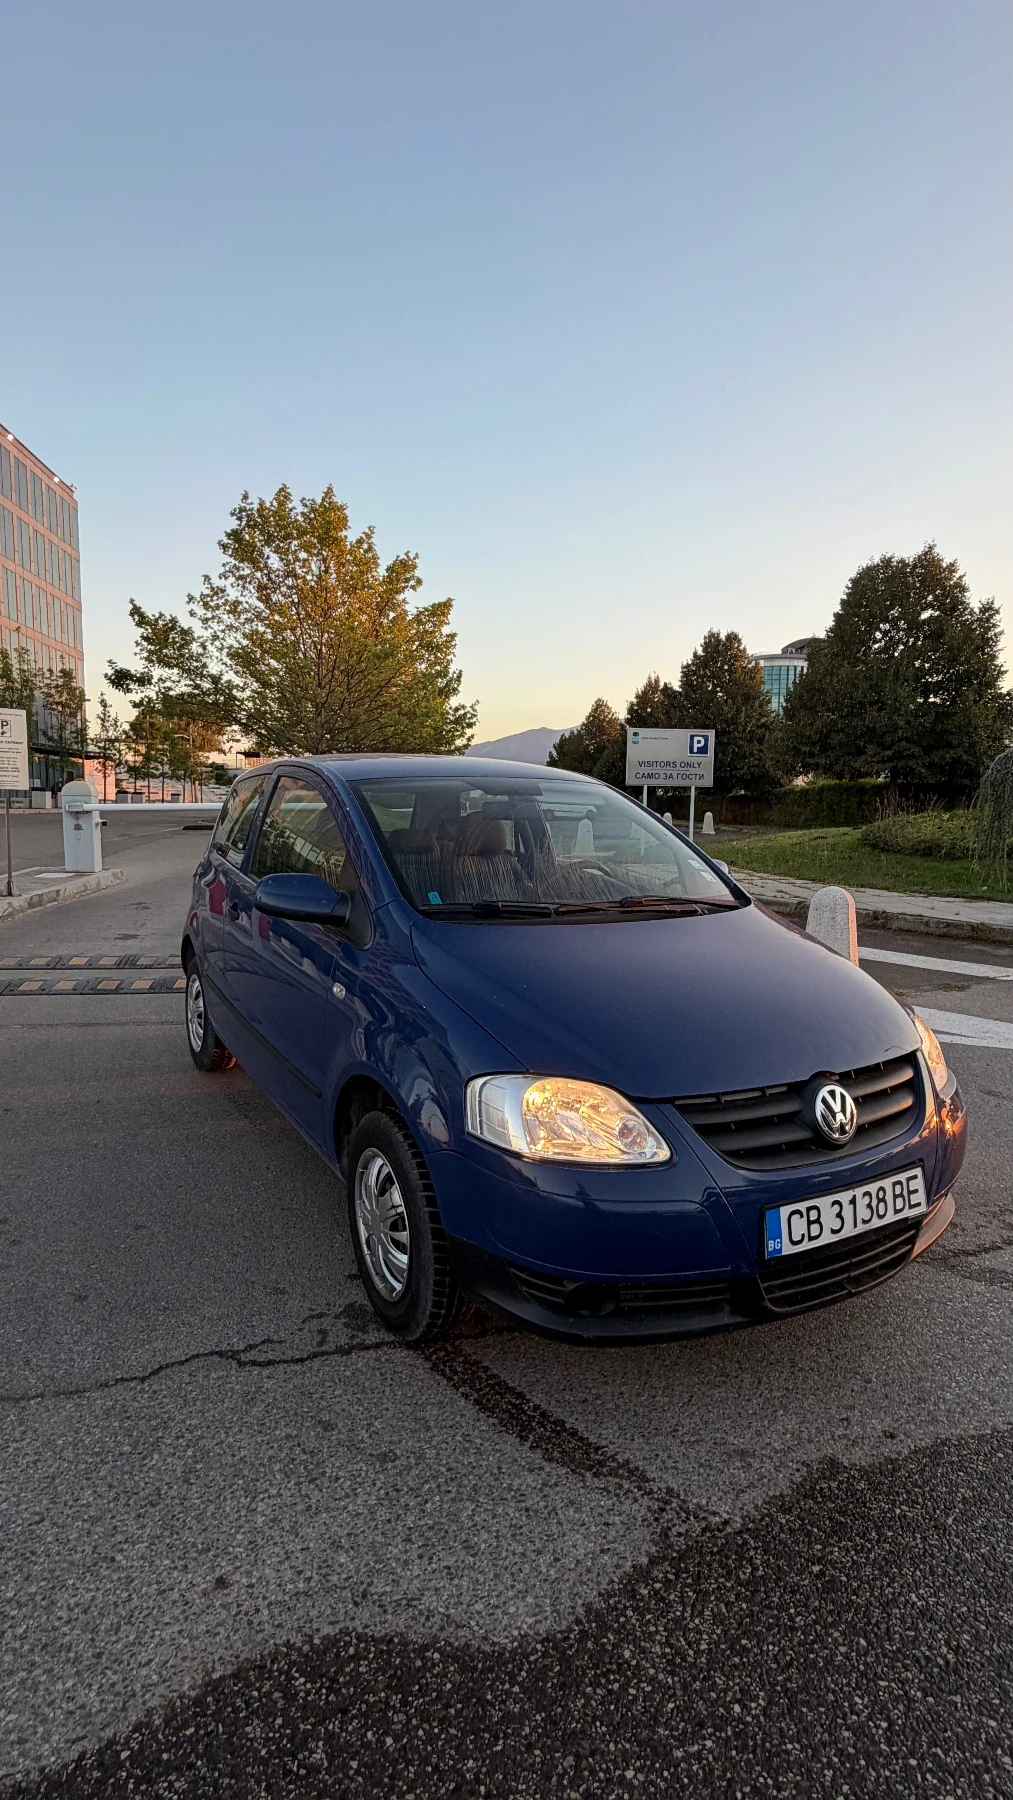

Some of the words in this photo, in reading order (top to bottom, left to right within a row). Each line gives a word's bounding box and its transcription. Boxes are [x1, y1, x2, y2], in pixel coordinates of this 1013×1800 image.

[1, 720, 9, 730] P
[693, 736, 705, 753] P
[637, 760, 677, 769] VISITORS
[679, 761, 703, 769] ONLY
[634, 772, 661, 780] САМО
[662, 772, 675, 780] ЗА
[676, 773, 705, 781] ГОСТИ
[814, 1084, 857, 1142] VW
[787, 1204, 824, 1246] CB
[830, 1186, 888, 1235] 3138
[892, 1174, 922, 1215] BE
[767, 1238, 782, 1251] BG
